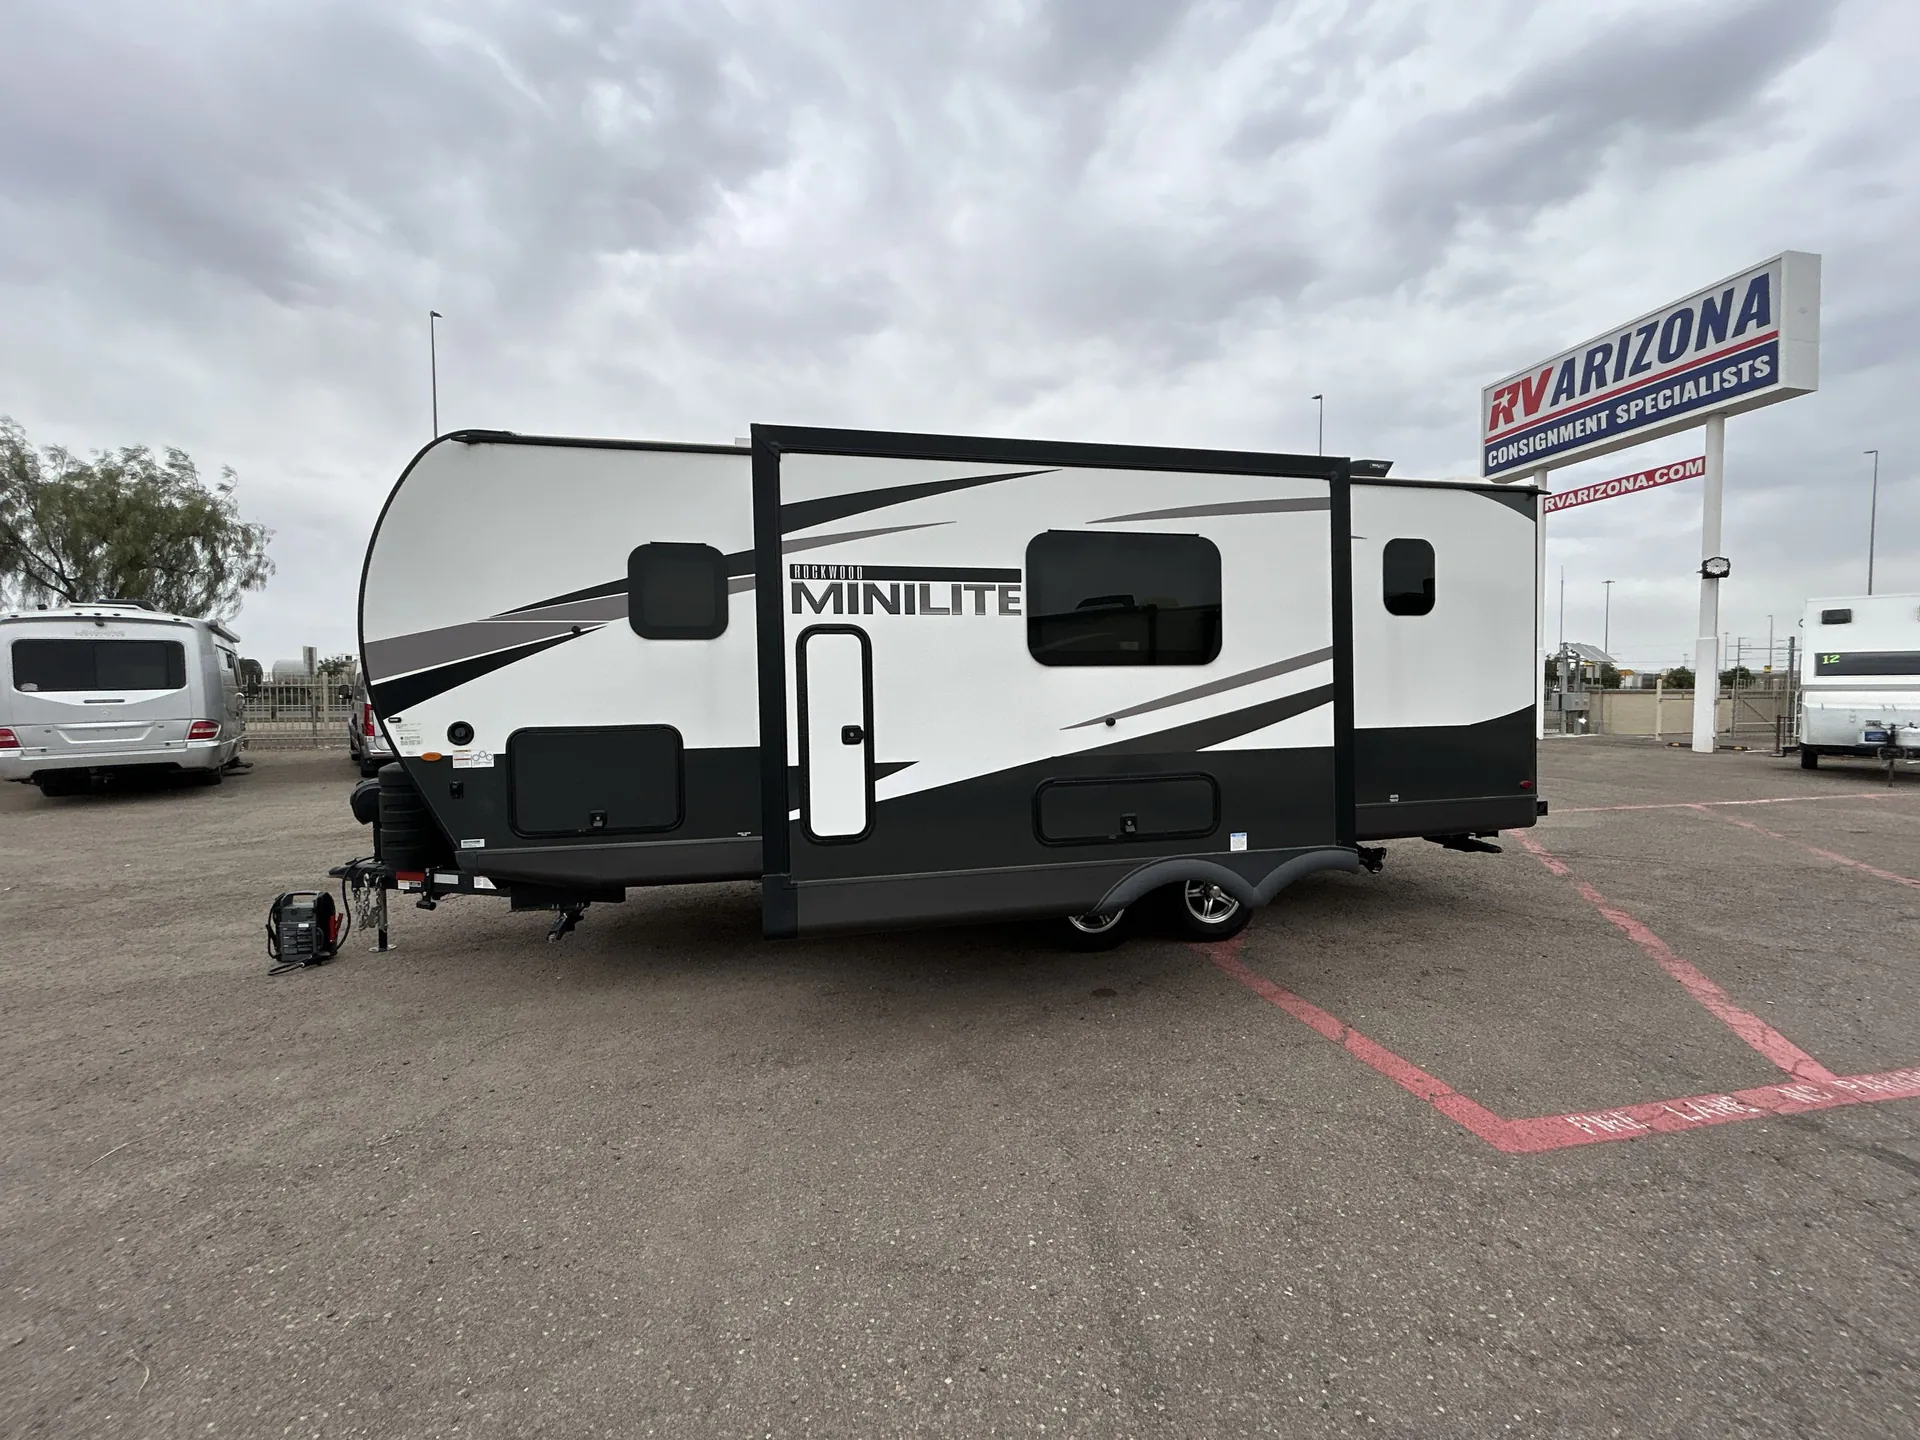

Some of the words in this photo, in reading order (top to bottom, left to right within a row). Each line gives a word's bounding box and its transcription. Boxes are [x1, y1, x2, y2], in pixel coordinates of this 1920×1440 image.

[1487, 411, 1610, 467] CONSIGNMENT
[1615, 354, 1771, 423] SPECIALISTS
[1544, 458, 1704, 512] RVARIZONA.COM
[794, 564, 863, 580] ROCKWOOD
[791, 581, 1022, 616] MINILITE
[1822, 654, 1841, 665] 12
[1564, 1111, 1650, 1136] FIRE
